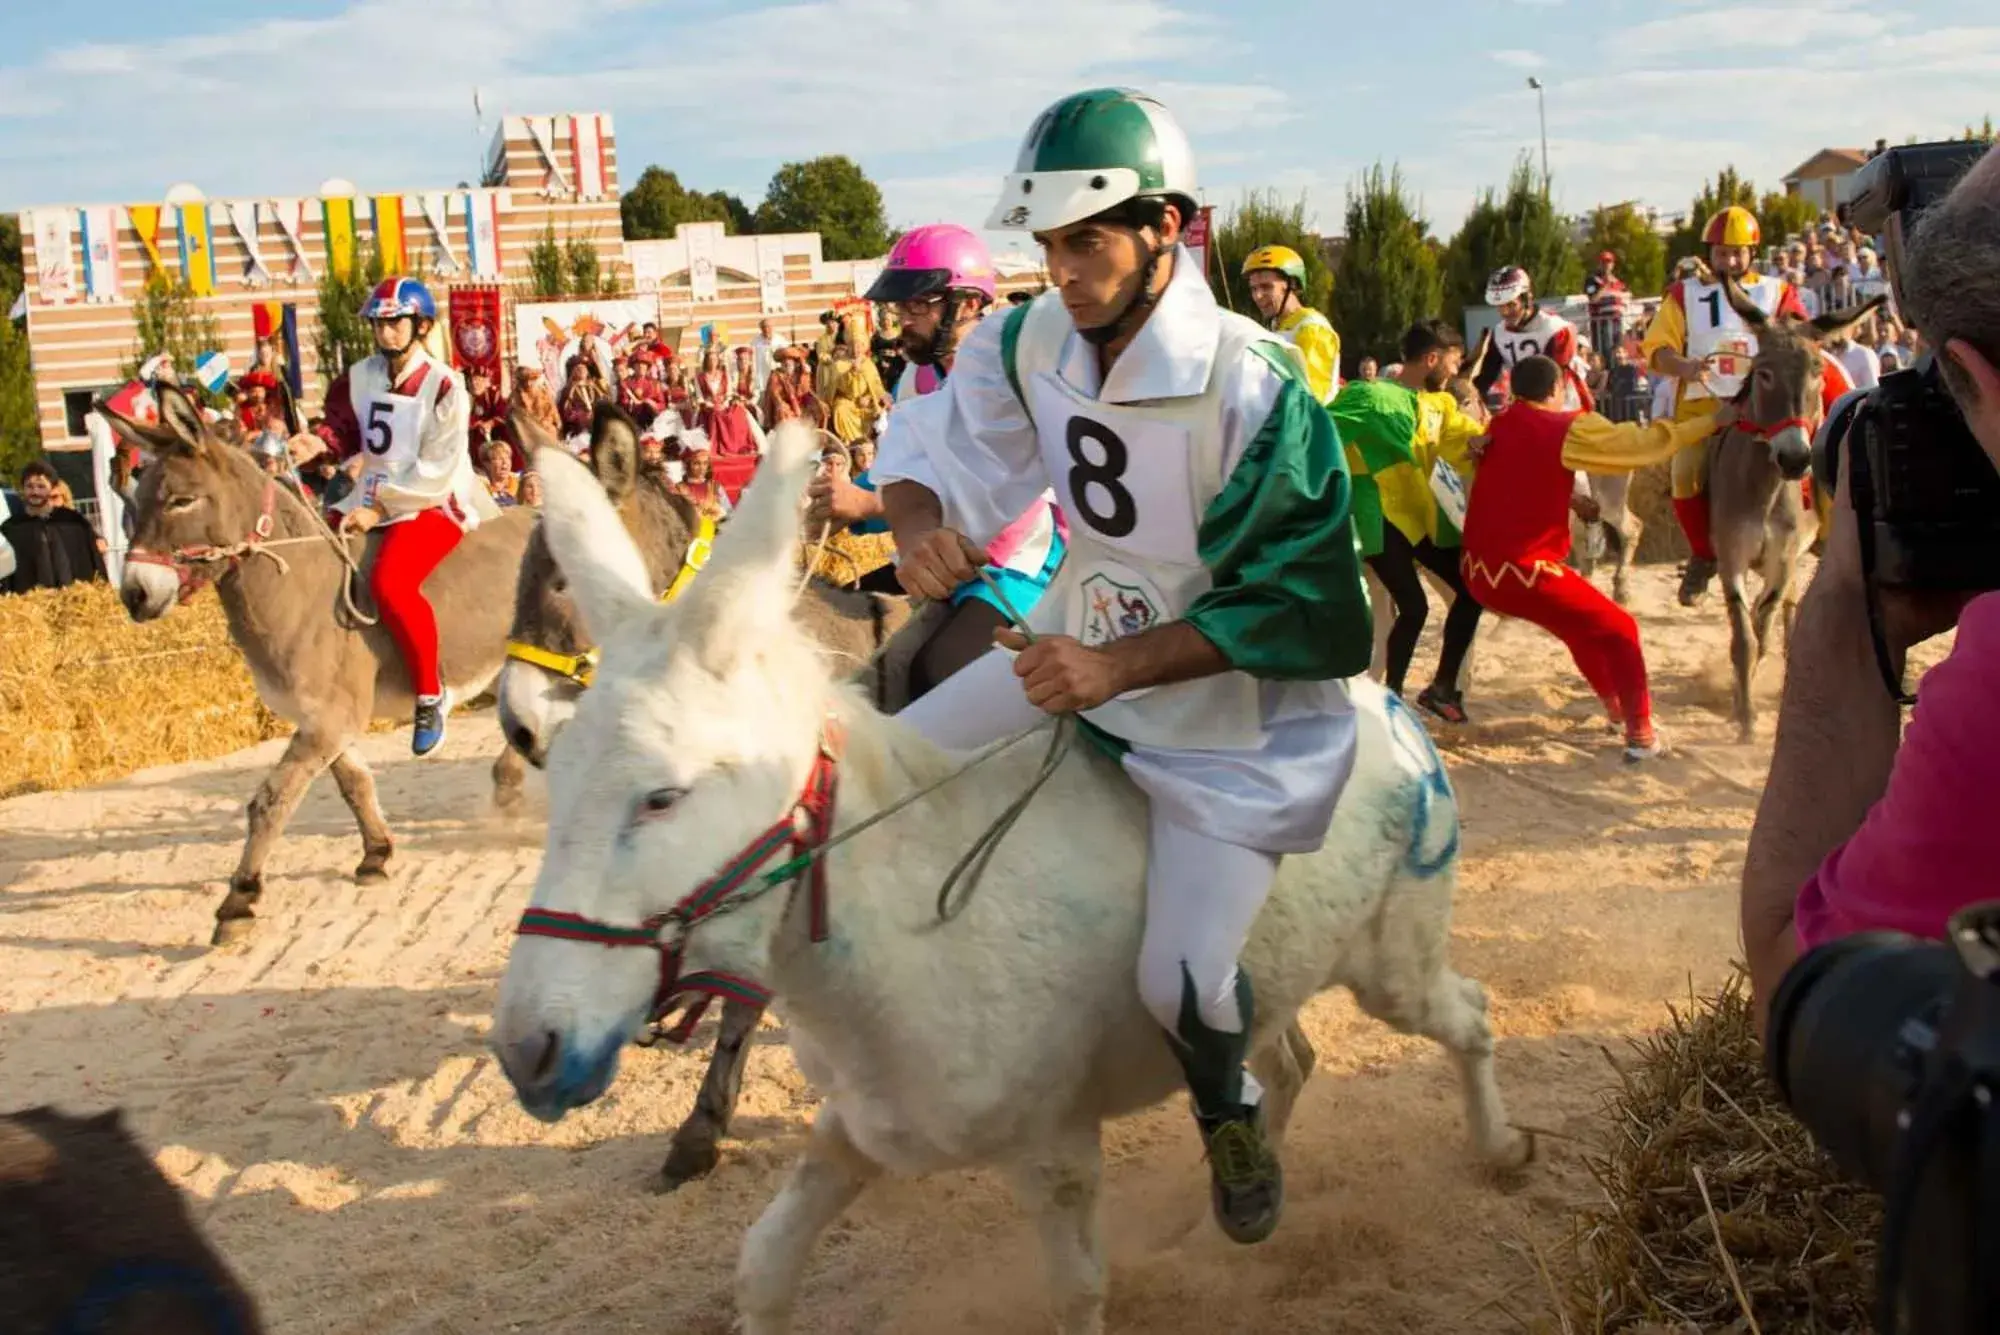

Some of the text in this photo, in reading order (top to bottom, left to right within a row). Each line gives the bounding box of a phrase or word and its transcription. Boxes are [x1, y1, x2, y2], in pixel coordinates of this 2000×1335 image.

[1699, 289, 1720, 328] 1
[365, 401, 394, 456] 5
[1066, 415, 1137, 538] 8
